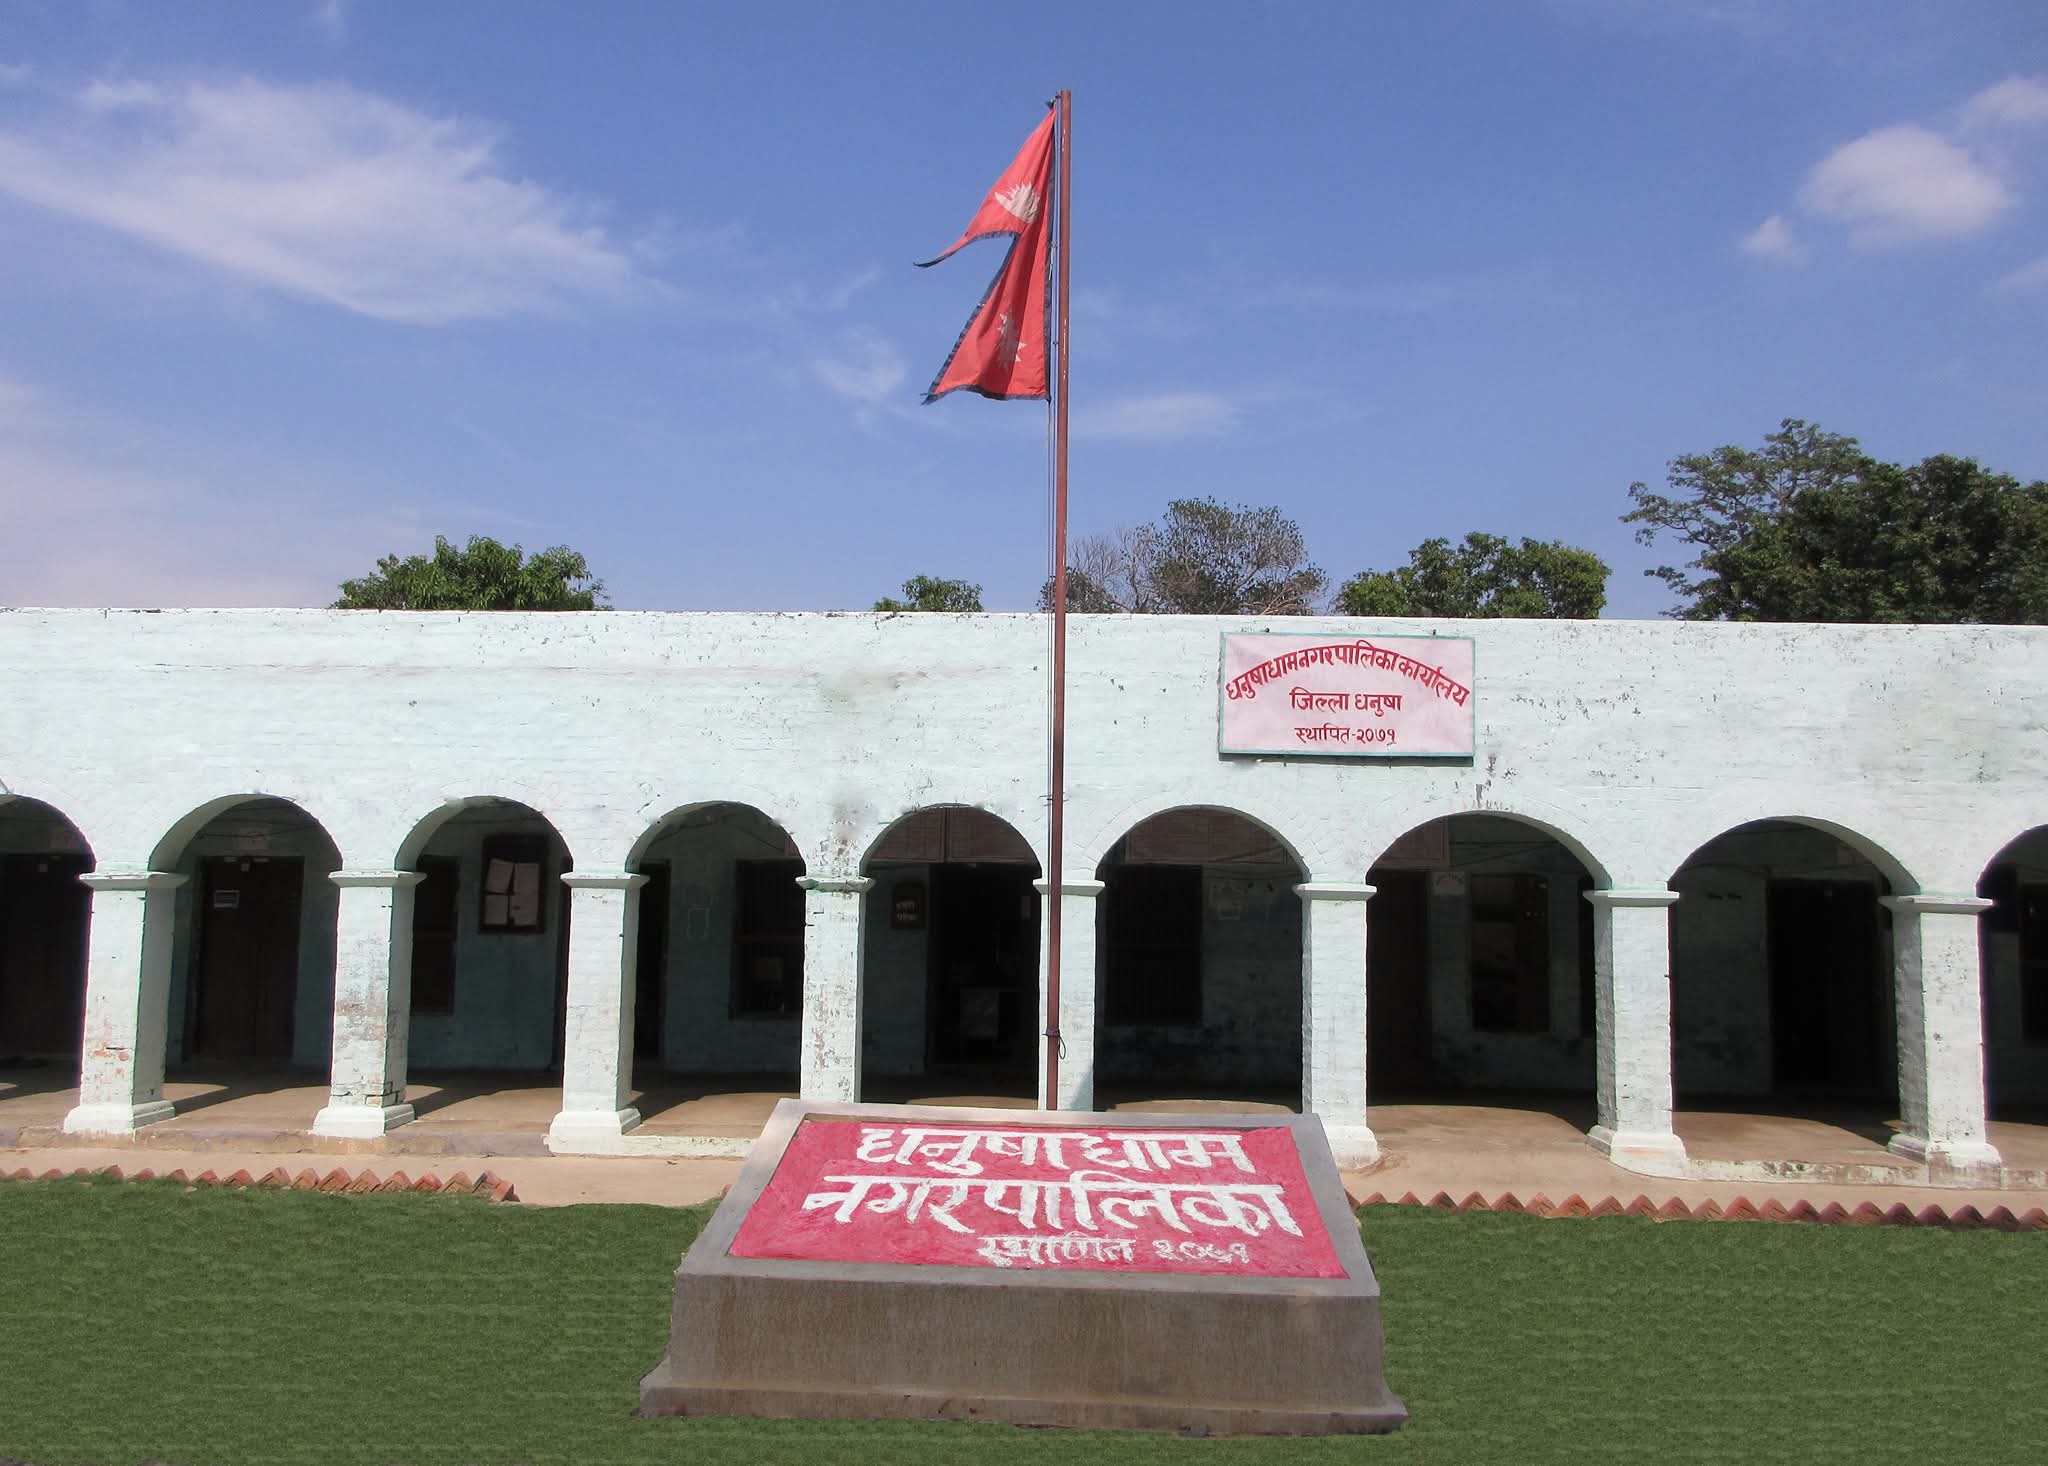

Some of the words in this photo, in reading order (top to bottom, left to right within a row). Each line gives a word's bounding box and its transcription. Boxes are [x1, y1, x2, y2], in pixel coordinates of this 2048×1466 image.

[1289, 686, 1350, 713] जिल्ला
[1355, 693, 1402, 717] धनुषा
[802, 1170, 1304, 1238] नगरपालिका
